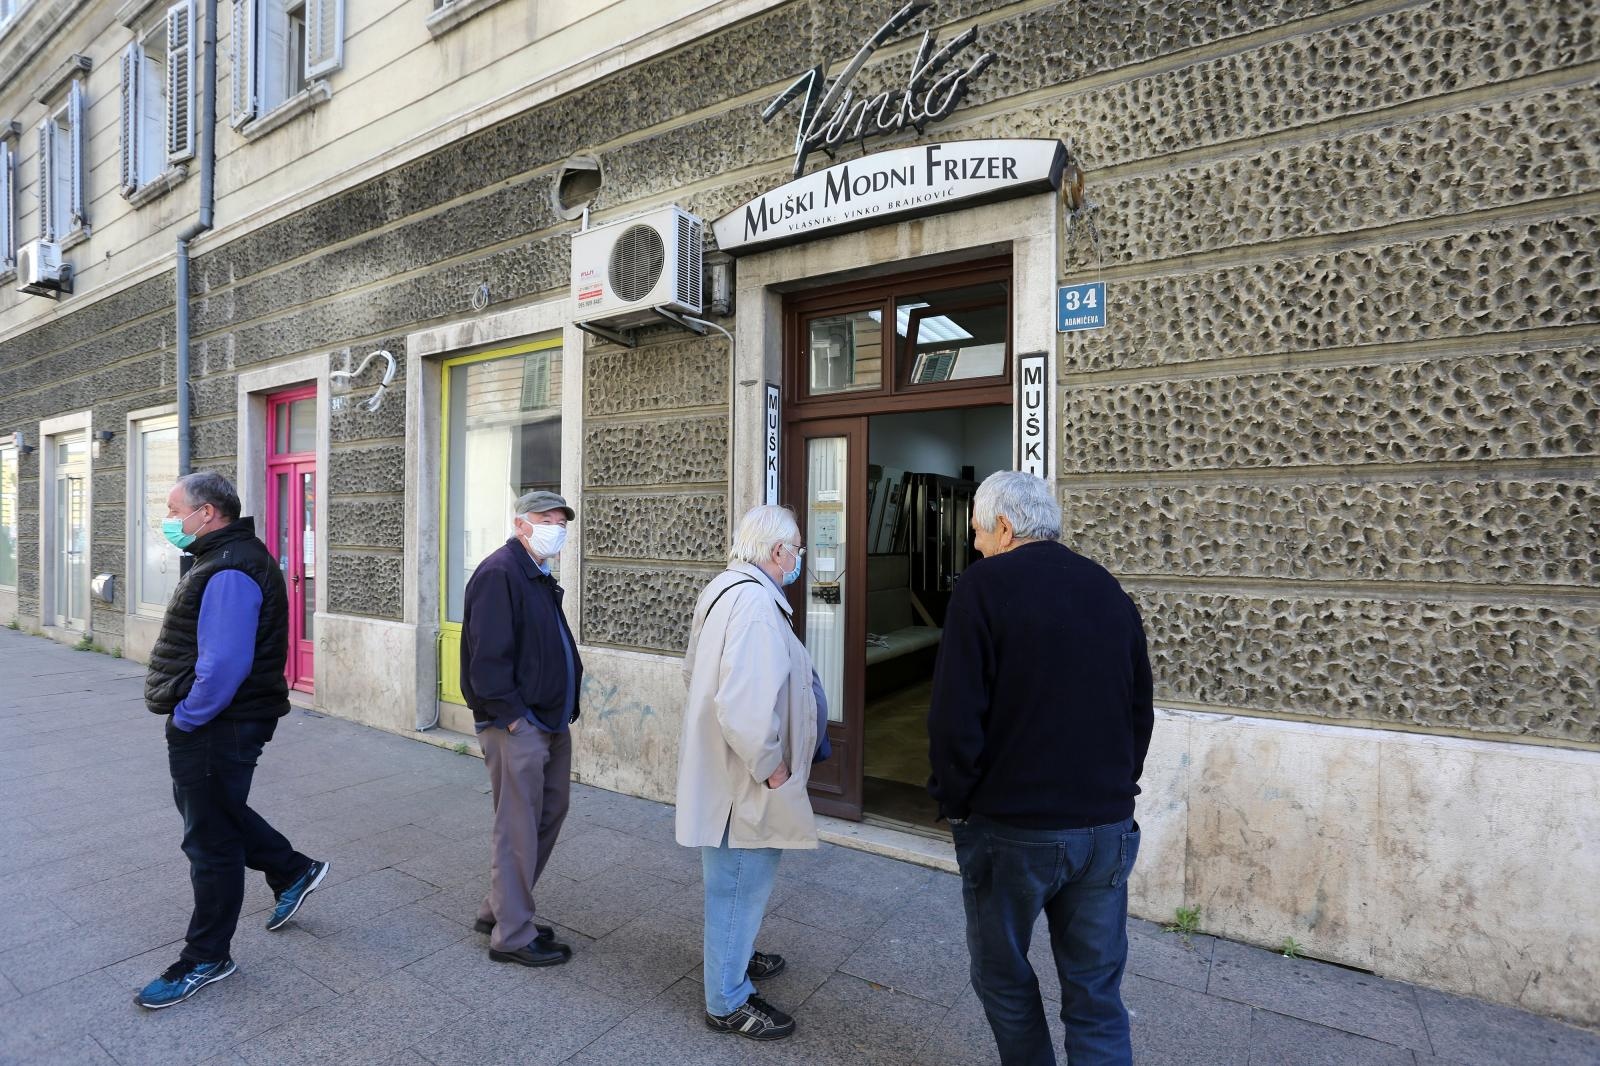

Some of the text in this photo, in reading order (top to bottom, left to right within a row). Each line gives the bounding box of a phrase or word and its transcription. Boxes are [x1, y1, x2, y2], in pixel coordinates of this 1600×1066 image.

[762, 0, 997, 179] Vinko
[824, 164, 915, 207] MODNI
[926, 144, 1018, 187] FRIZER
[788, 187, 955, 231] VLASNIK: VINKO BRAJKOVIĆ
[1066, 288, 1097, 310] 34
[768, 394, 778, 491] MUŠKI
